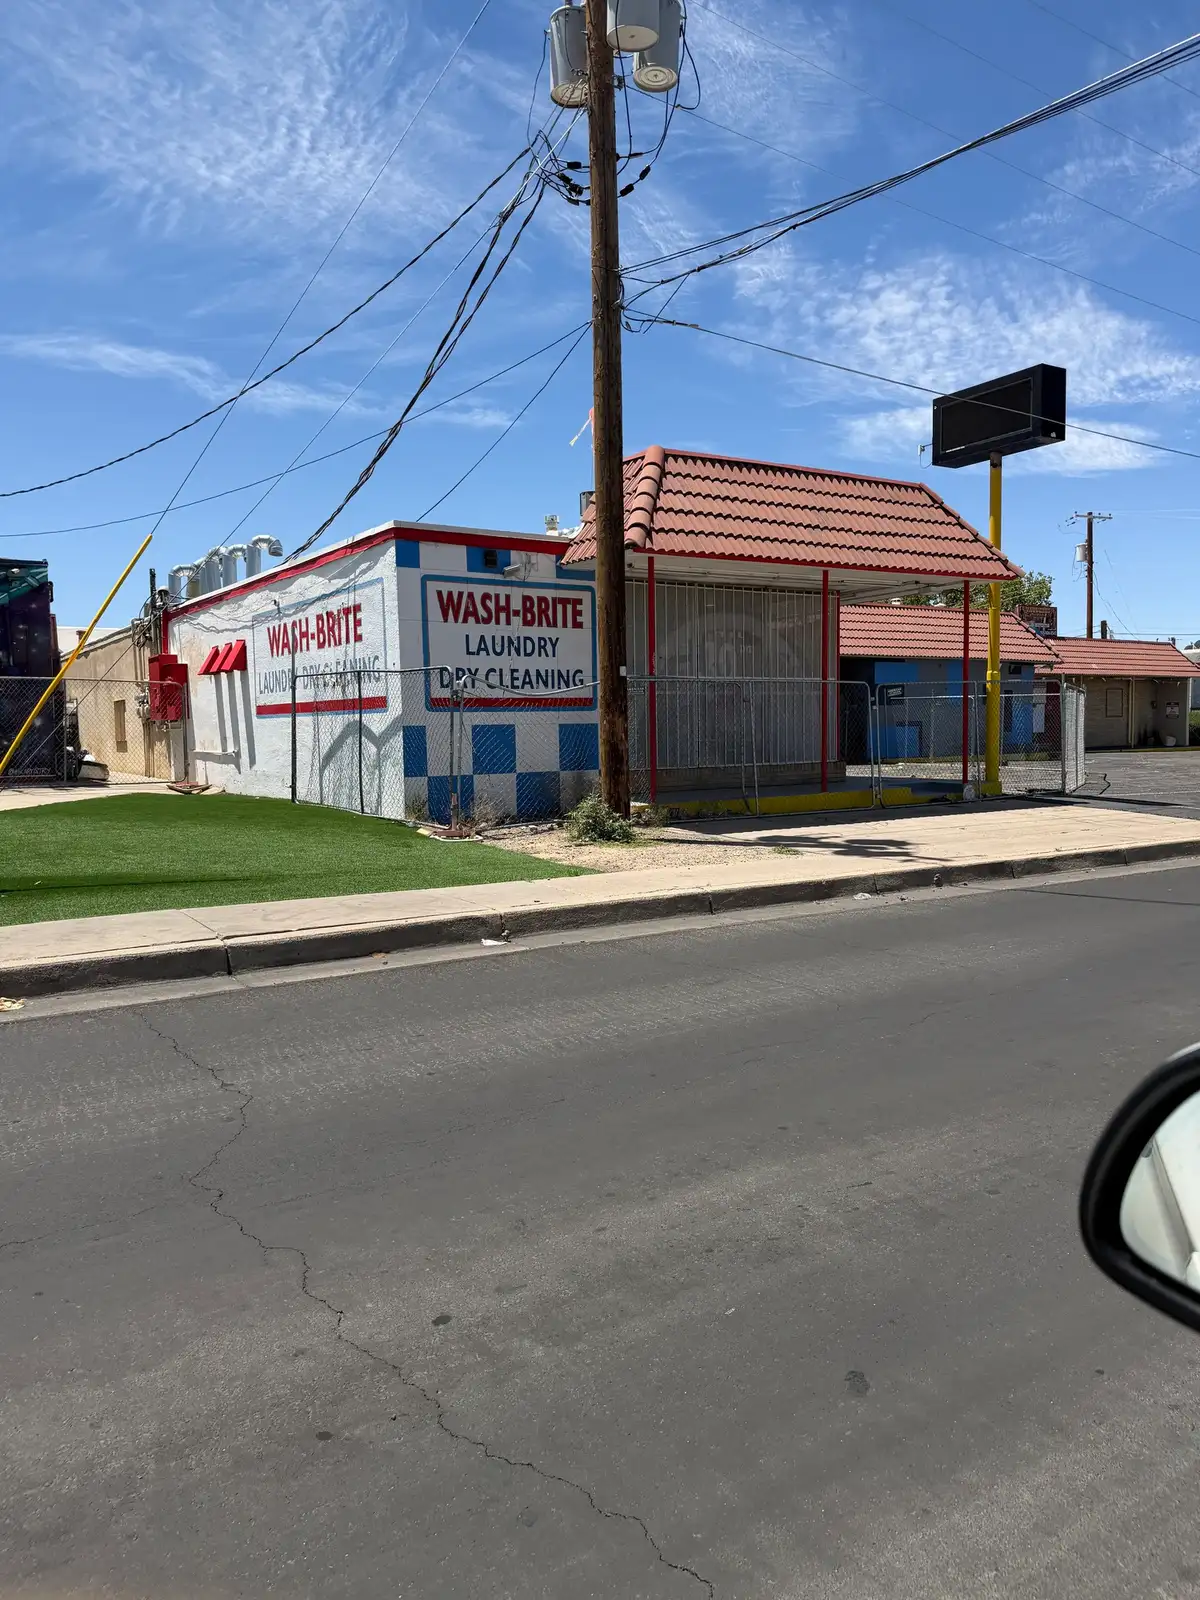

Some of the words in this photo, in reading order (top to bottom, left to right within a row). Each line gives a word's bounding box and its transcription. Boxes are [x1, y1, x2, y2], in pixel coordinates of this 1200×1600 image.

[436, 590, 584, 629] WASH-BRITE
[267, 603, 363, 658] WASH-BRITE
[465, 634, 559, 658] LAUNDRY
[302, 663, 320, 690] DRY
[439, 667, 479, 689] DRY
[485, 668, 584, 690] CLEANING
